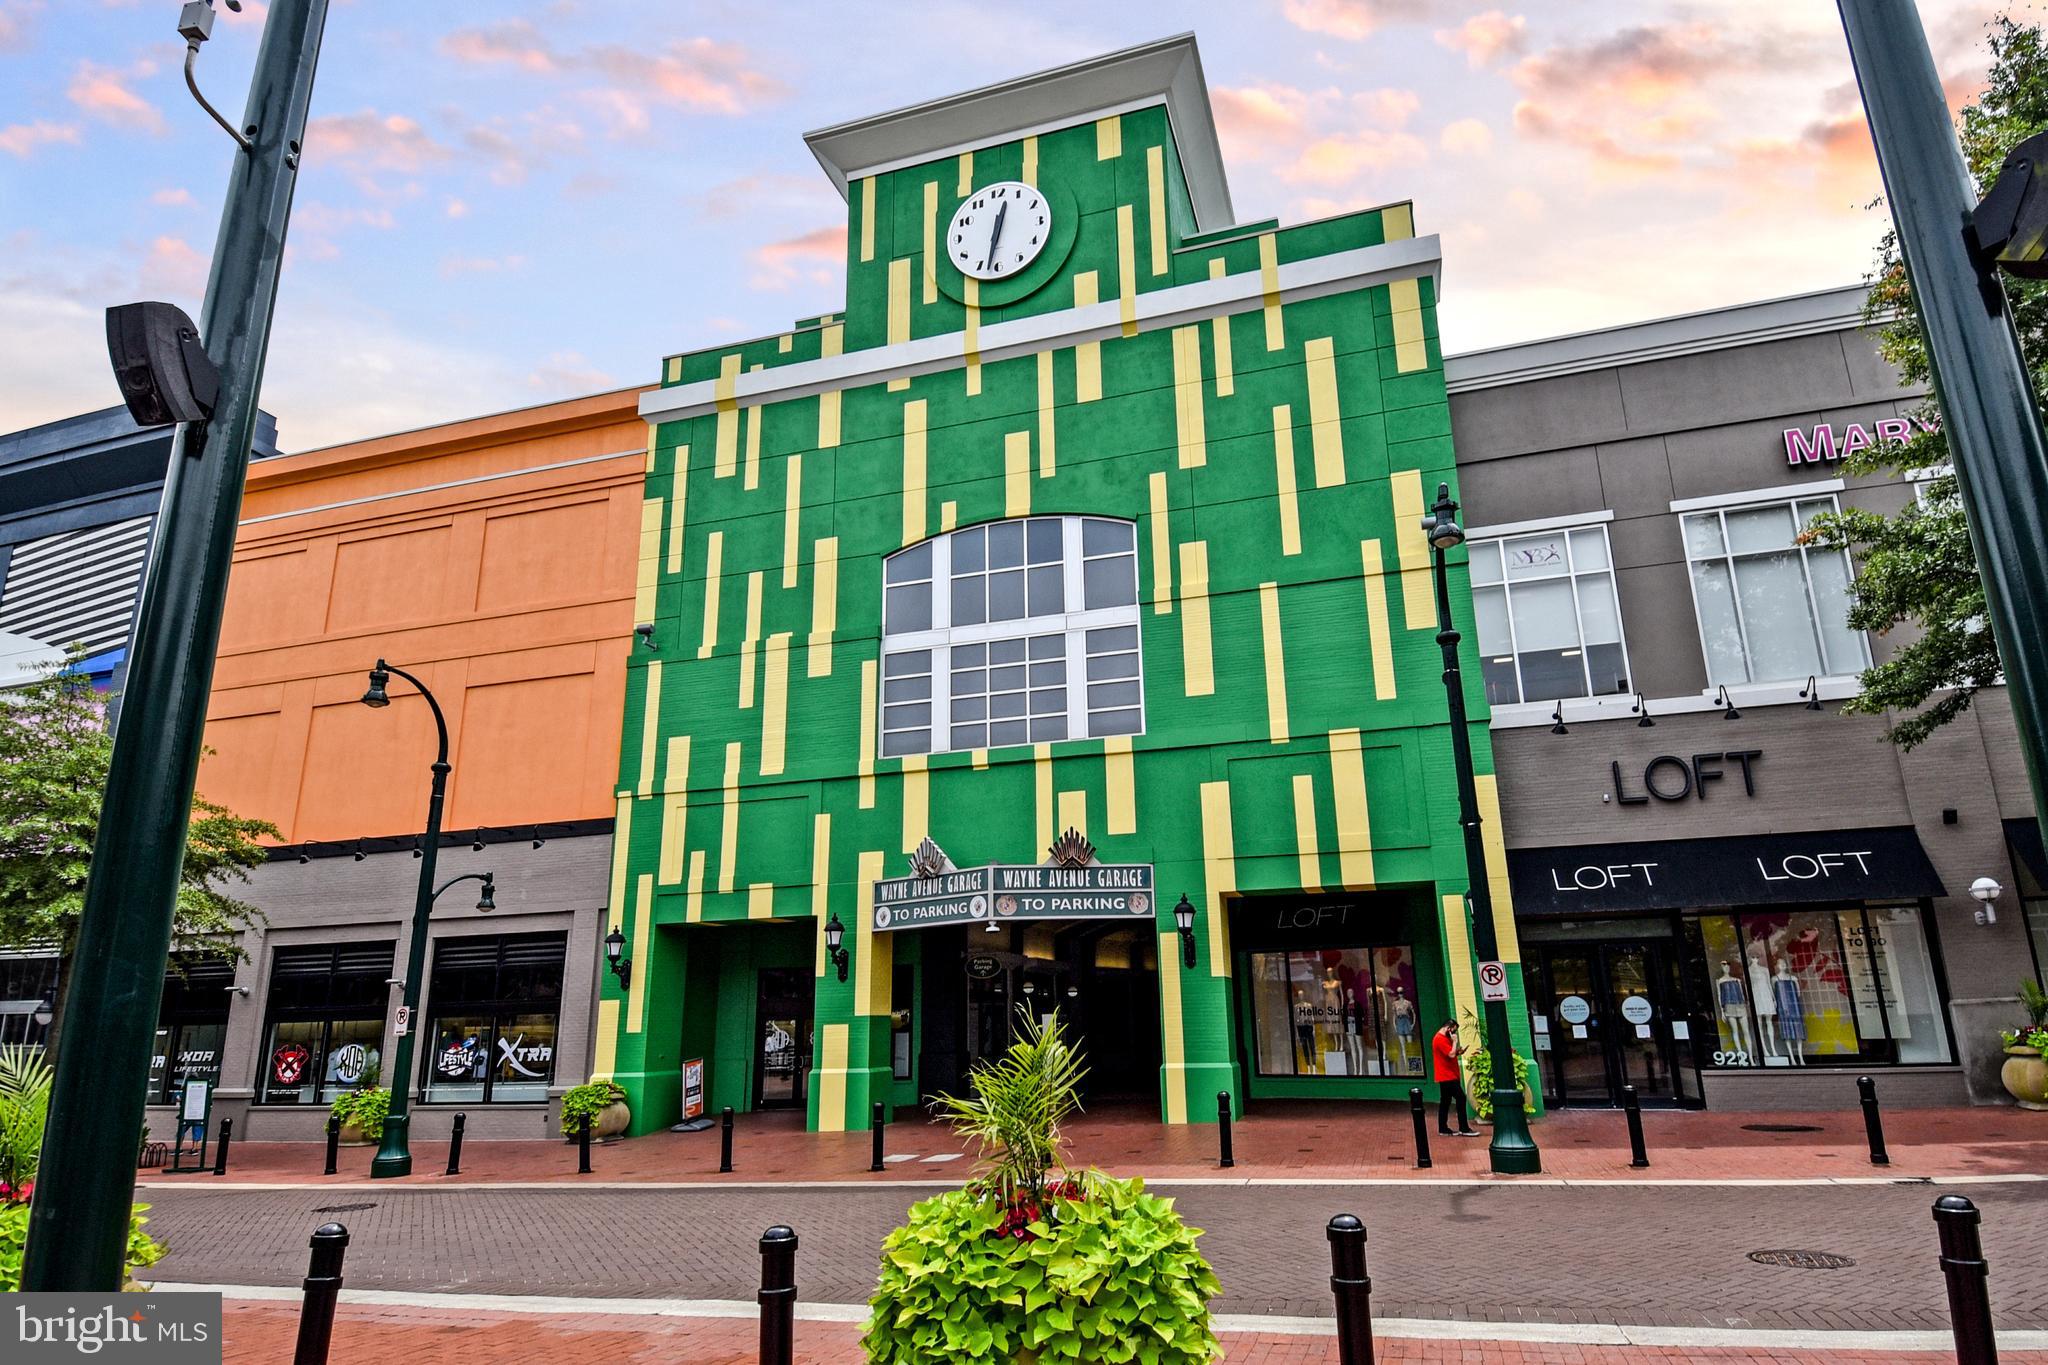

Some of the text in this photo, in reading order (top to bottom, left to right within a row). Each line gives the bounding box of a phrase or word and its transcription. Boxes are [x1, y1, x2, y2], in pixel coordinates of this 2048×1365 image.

[990, 188, 1005, 199] 12
[1016, 189, 1021, 199] 1
[972, 199, 984, 210] 11
[1029, 199, 1038, 209] 2
[960, 215, 974, 227] 10
[1036, 216, 1044, 226] 3
[953, 234, 962, 245] 9
[1029, 235, 1037, 245] 4
[960, 250, 968, 261] 8
[1015, 252, 1024, 262] 5
[976, 260, 984, 271] 7
[994, 261, 1003, 272] 6
[1612, 750, 1762, 804] LOFT
[1757, 851, 1872, 880] LOFT
[1003, 869, 1143, 888] WAYNE AVENUE GARAGE
[1551, 863, 1658, 890] LOFT
[881, 872, 982, 901] WAYNE AVENUE GARAGE
[1022, 897, 1125, 910] TO PARKING
[893, 902, 968, 921] TO PARKING
[1277, 904, 1356, 928] LOFT
[1848, 938, 1863, 946] TO
[1299, 1006, 1324, 1017] Hello
[174, 1065, 219, 1073] LIFESTYLE
